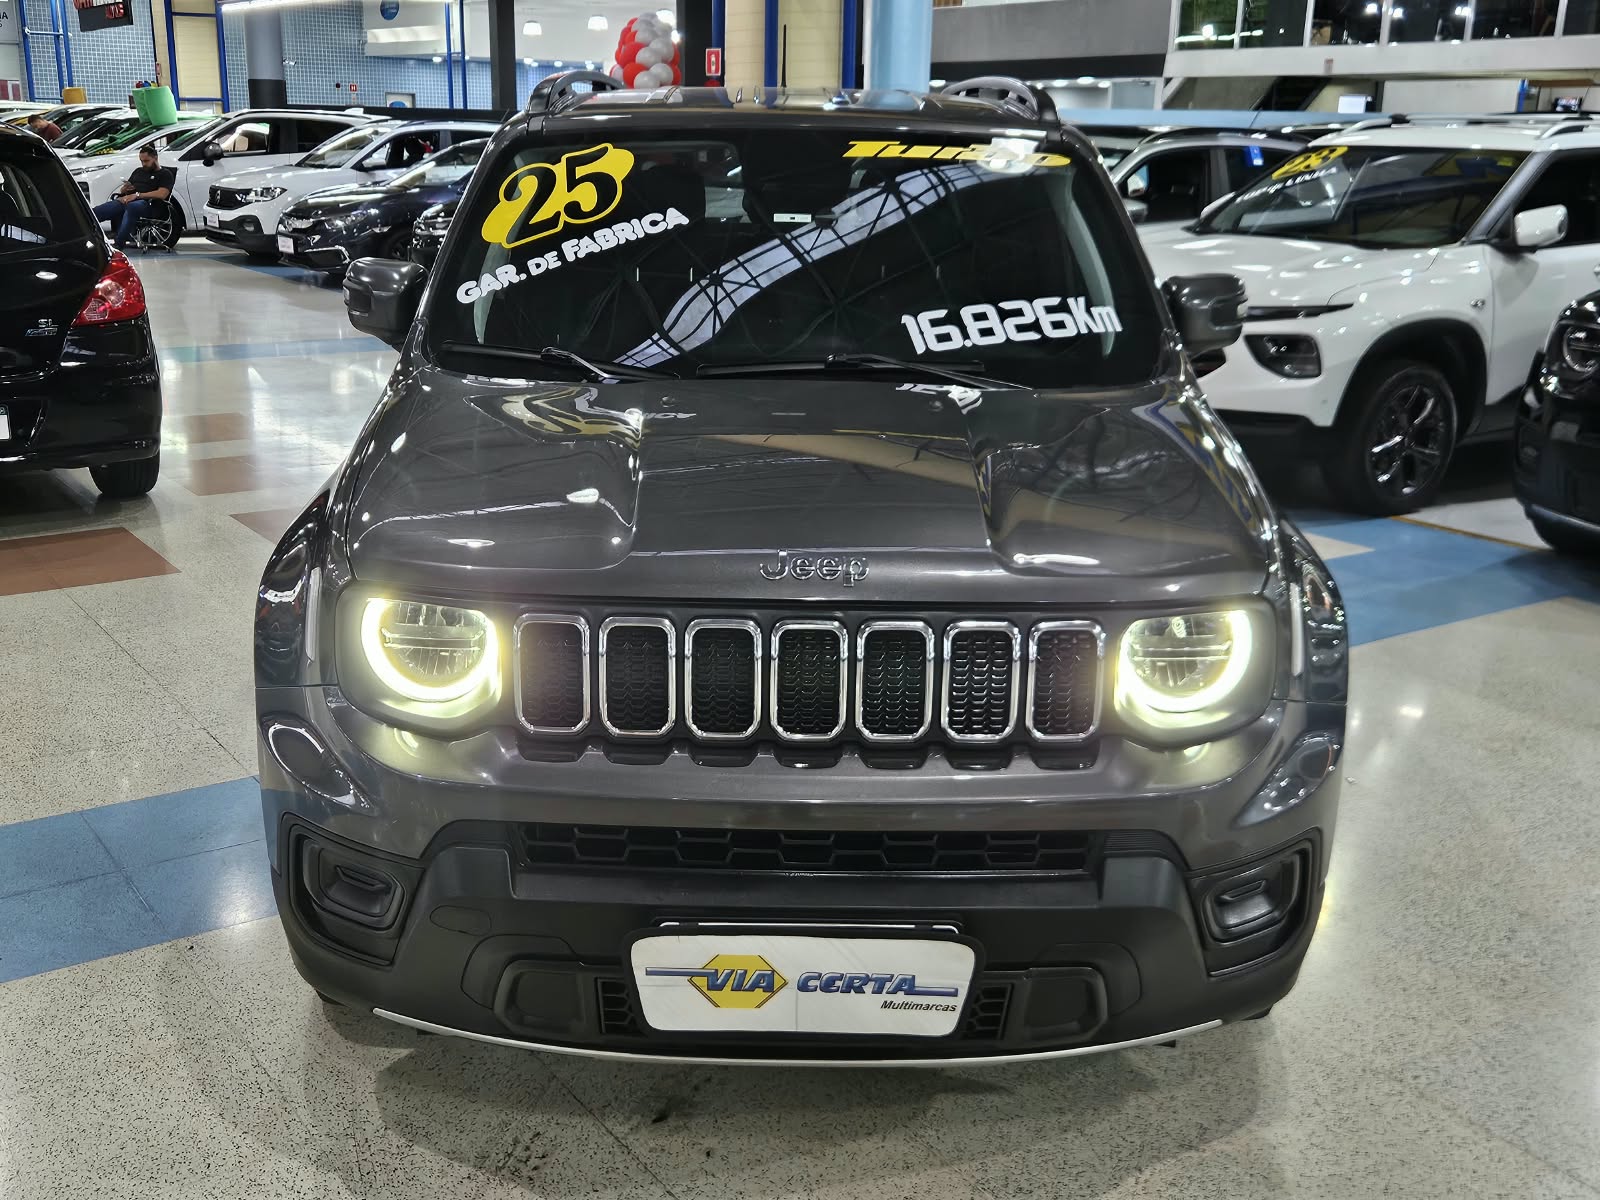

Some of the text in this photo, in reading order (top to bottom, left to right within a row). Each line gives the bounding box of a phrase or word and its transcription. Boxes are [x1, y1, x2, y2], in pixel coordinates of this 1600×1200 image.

[501, 145, 620, 246] 25
[456, 207, 690, 304] GAR. DE FABRICA
[760, 549, 870, 587] Jeep
[706, 968, 775, 992] VIA
[880, 1000, 958, 1013] Multimarcas
